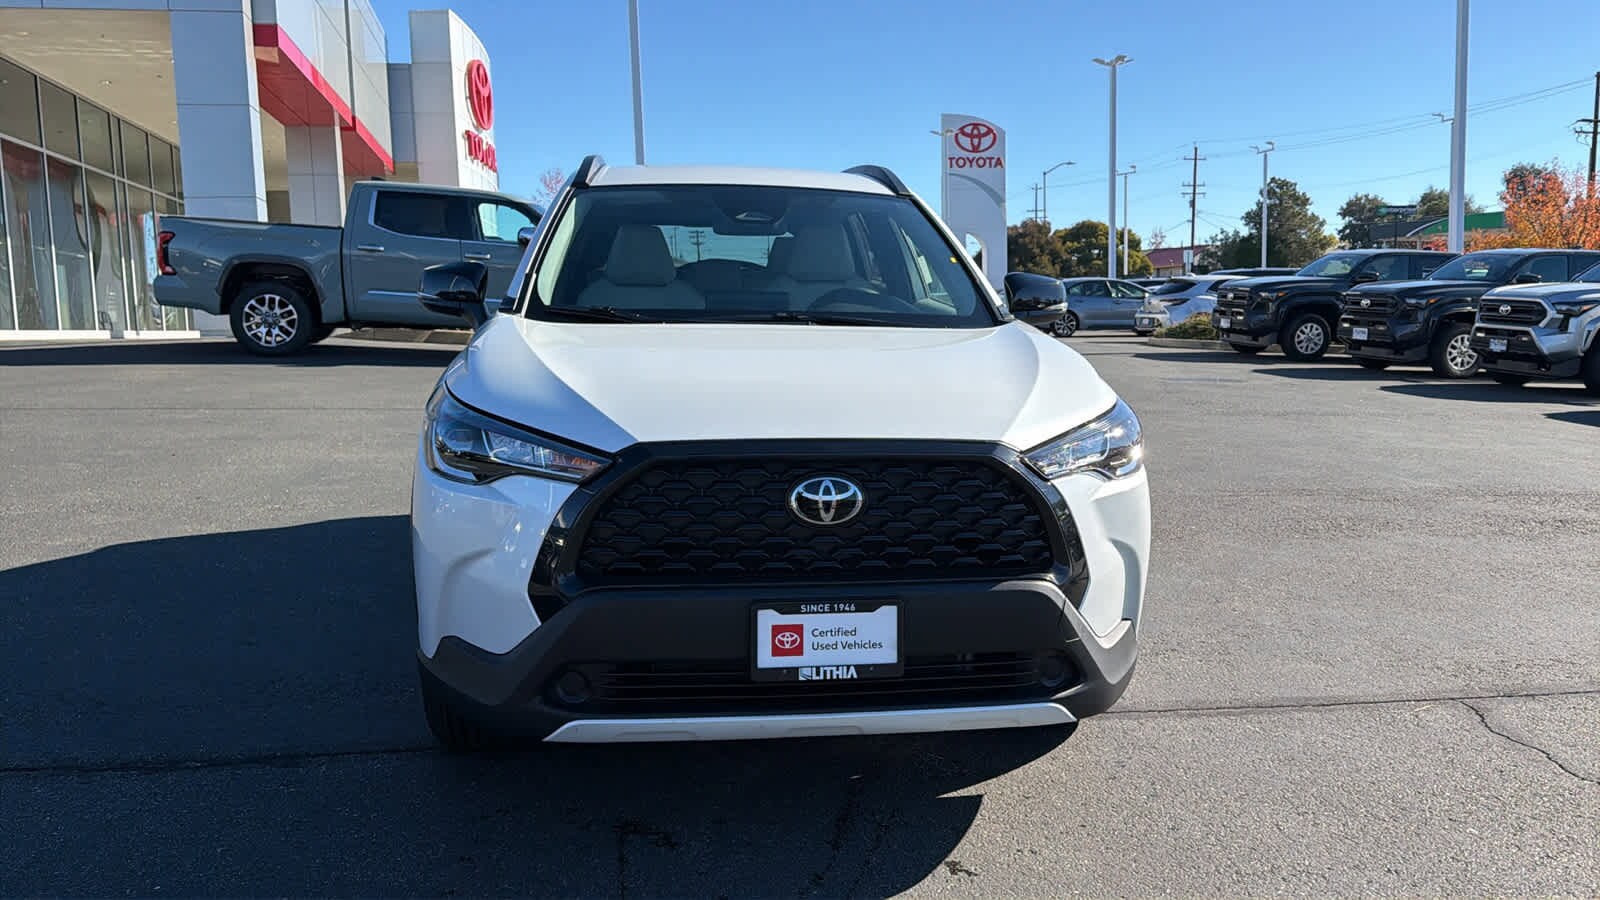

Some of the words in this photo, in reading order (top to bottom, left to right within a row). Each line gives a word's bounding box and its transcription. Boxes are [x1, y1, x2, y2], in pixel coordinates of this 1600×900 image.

[465, 130, 497, 173] TOYO
[948, 156, 1004, 169] TOYOTA
[800, 604, 830, 613] SINCE
[834, 603, 856, 612] 1946
[811, 627, 857, 638] Certified
[811, 640, 838, 651] Used
[840, 639, 884, 650] Vehicles
[812, 666, 858, 680] LITHIA
